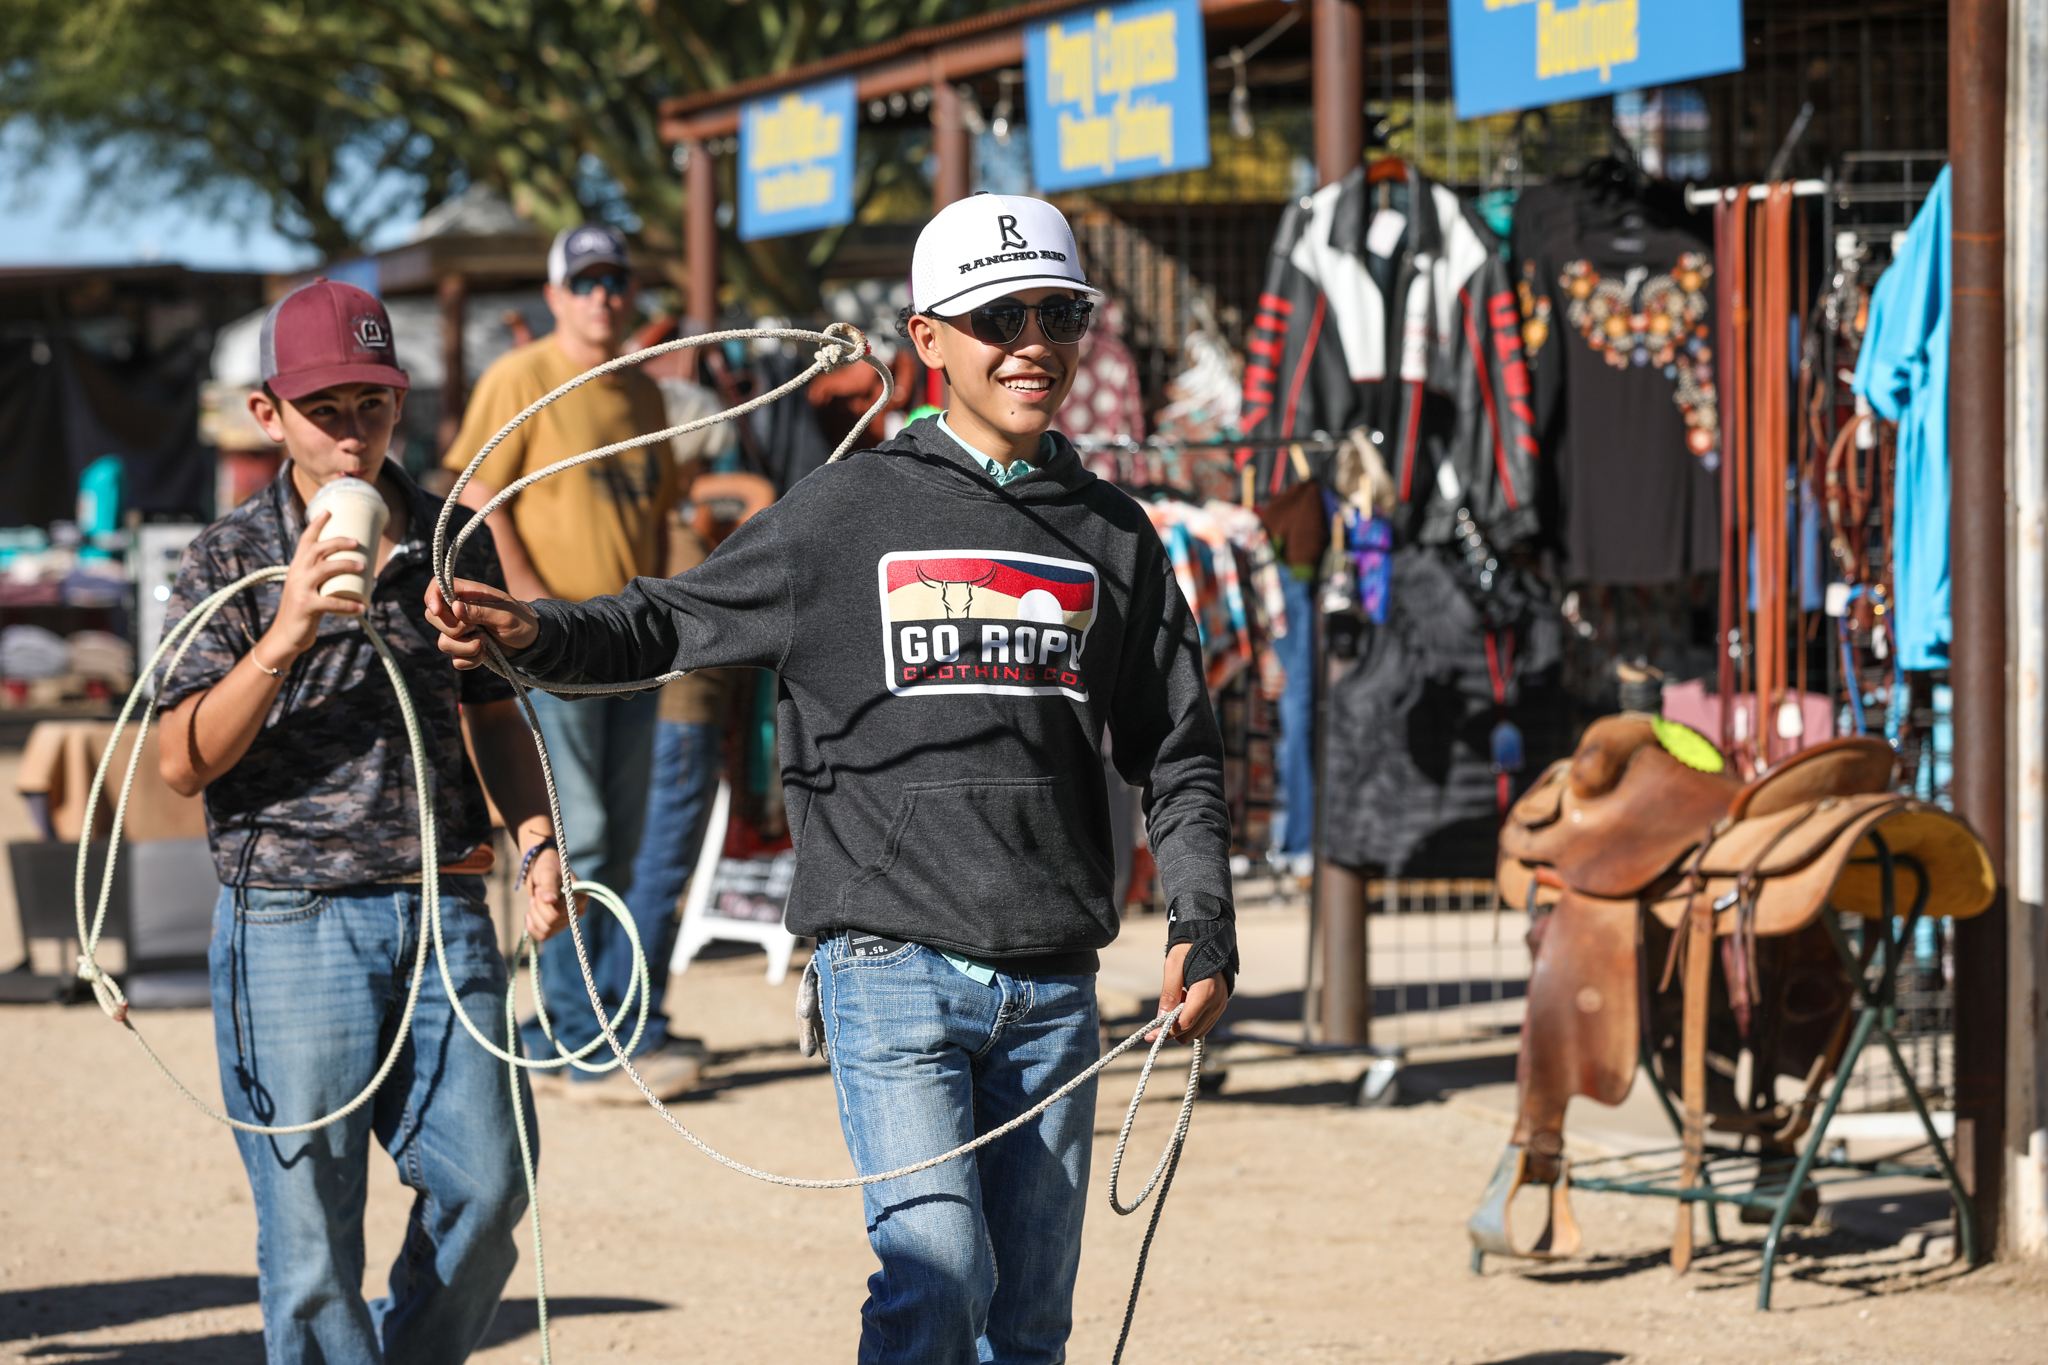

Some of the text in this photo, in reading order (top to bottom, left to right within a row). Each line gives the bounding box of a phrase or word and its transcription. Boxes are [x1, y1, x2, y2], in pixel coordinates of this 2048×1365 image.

[958, 250, 1067, 275] RANCHO RIO
[900, 625, 960, 664] GO
[903, 664, 1036, 681] CLOTHING
